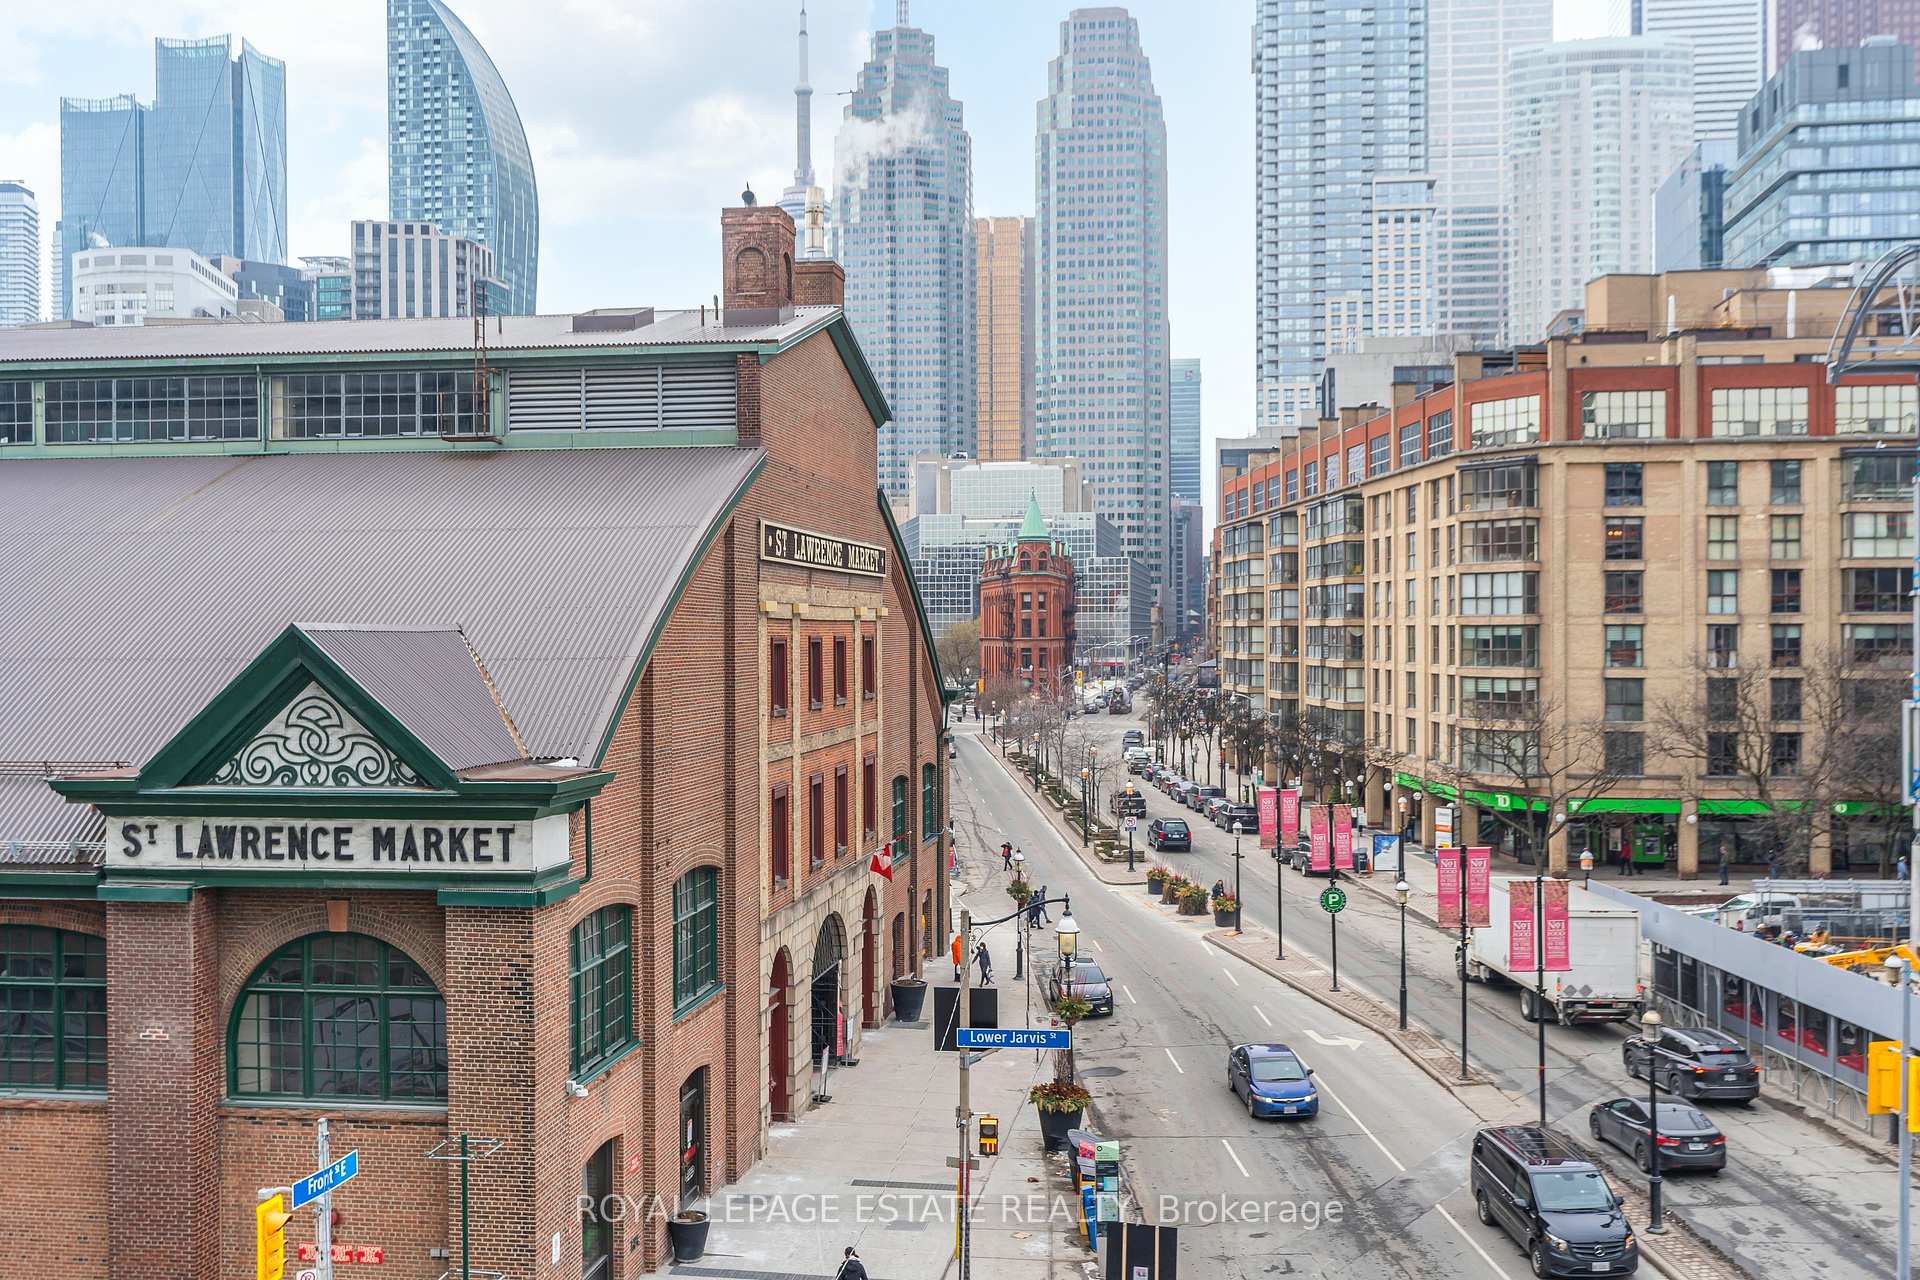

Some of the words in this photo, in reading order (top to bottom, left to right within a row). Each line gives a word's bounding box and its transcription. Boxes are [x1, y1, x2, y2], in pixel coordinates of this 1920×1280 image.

[794, 533, 843, 567] LAWRENCE
[848, 545, 880, 572] MARKET
[1495, 794, 1510, 807] TD
[175, 824, 355, 862] LAWRENCE
[372, 825, 517, 864] MARKET
[1328, 893, 1340, 904] P
[970, 1030, 1007, 1043] Lower
[1010, 1031, 1047, 1044] Jarvis
[307, 1171, 333, 1195] Front
[340, 1160, 347, 1177] E
